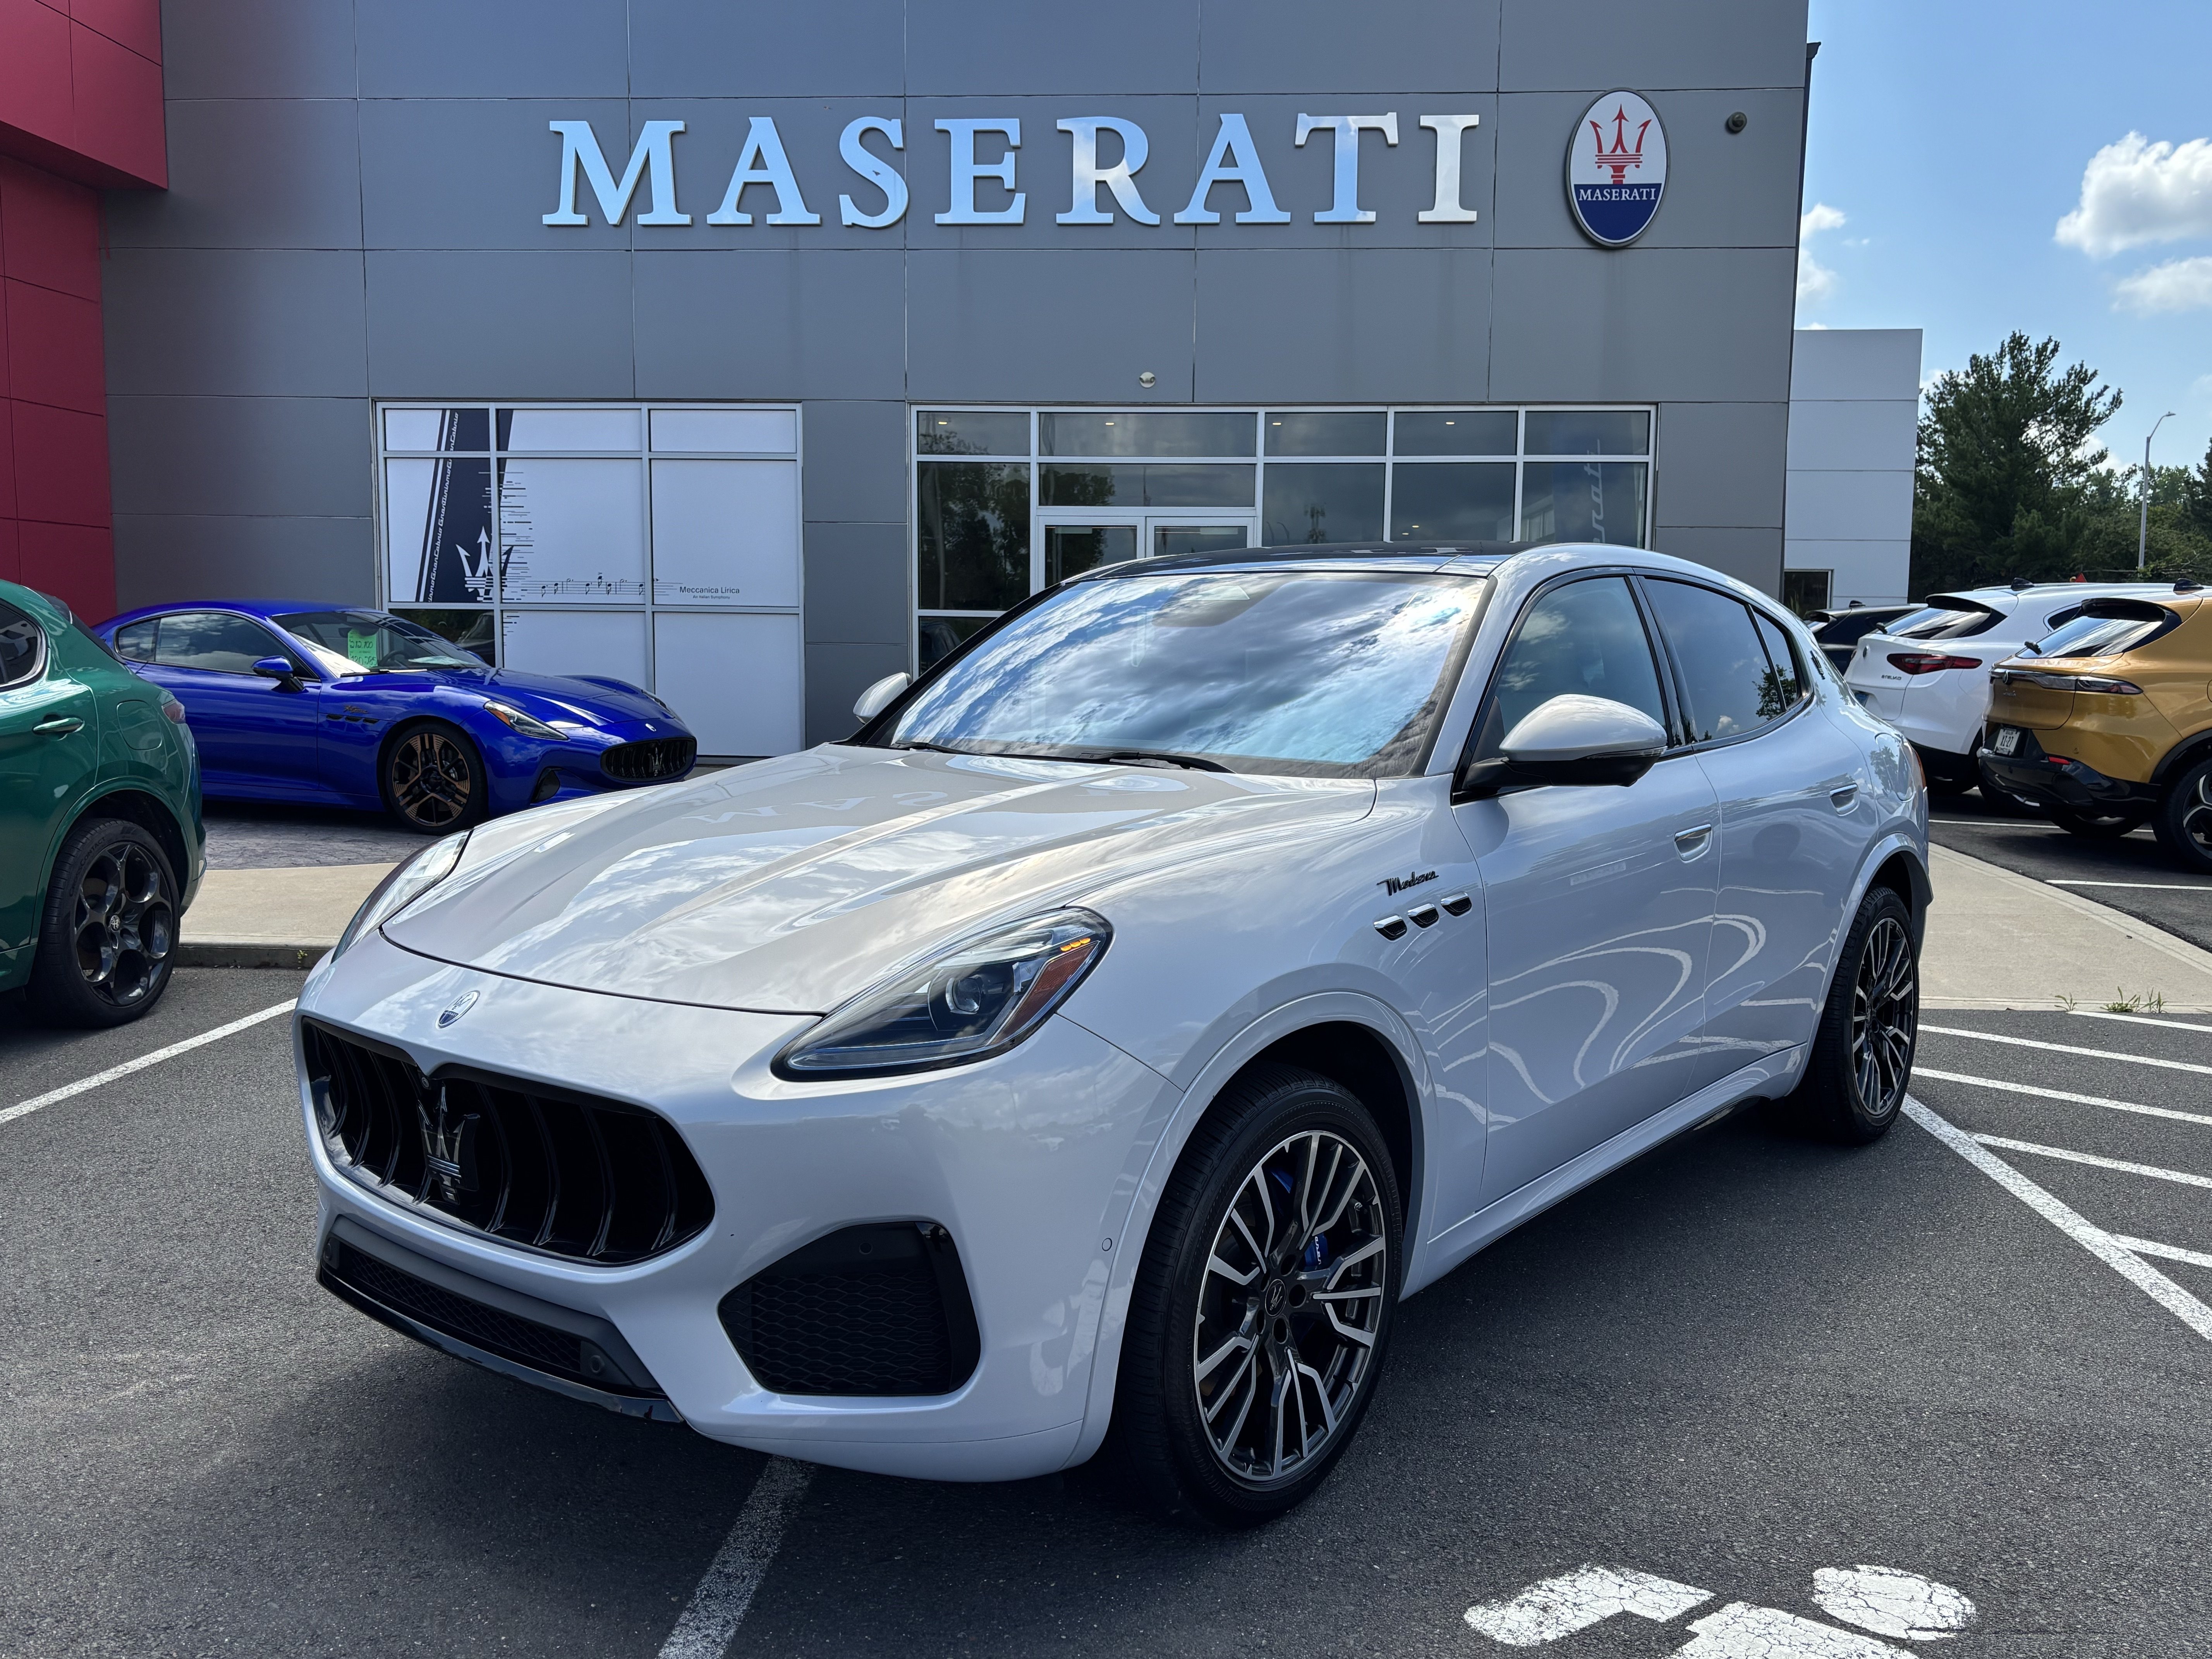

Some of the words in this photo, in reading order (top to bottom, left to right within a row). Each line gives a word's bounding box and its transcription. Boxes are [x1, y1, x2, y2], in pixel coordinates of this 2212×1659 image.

[542, 112, 1479, 229] MASERATI
[1579, 188, 1656, 201] MASERATI
[1376, 871, 1439, 896] Modena
